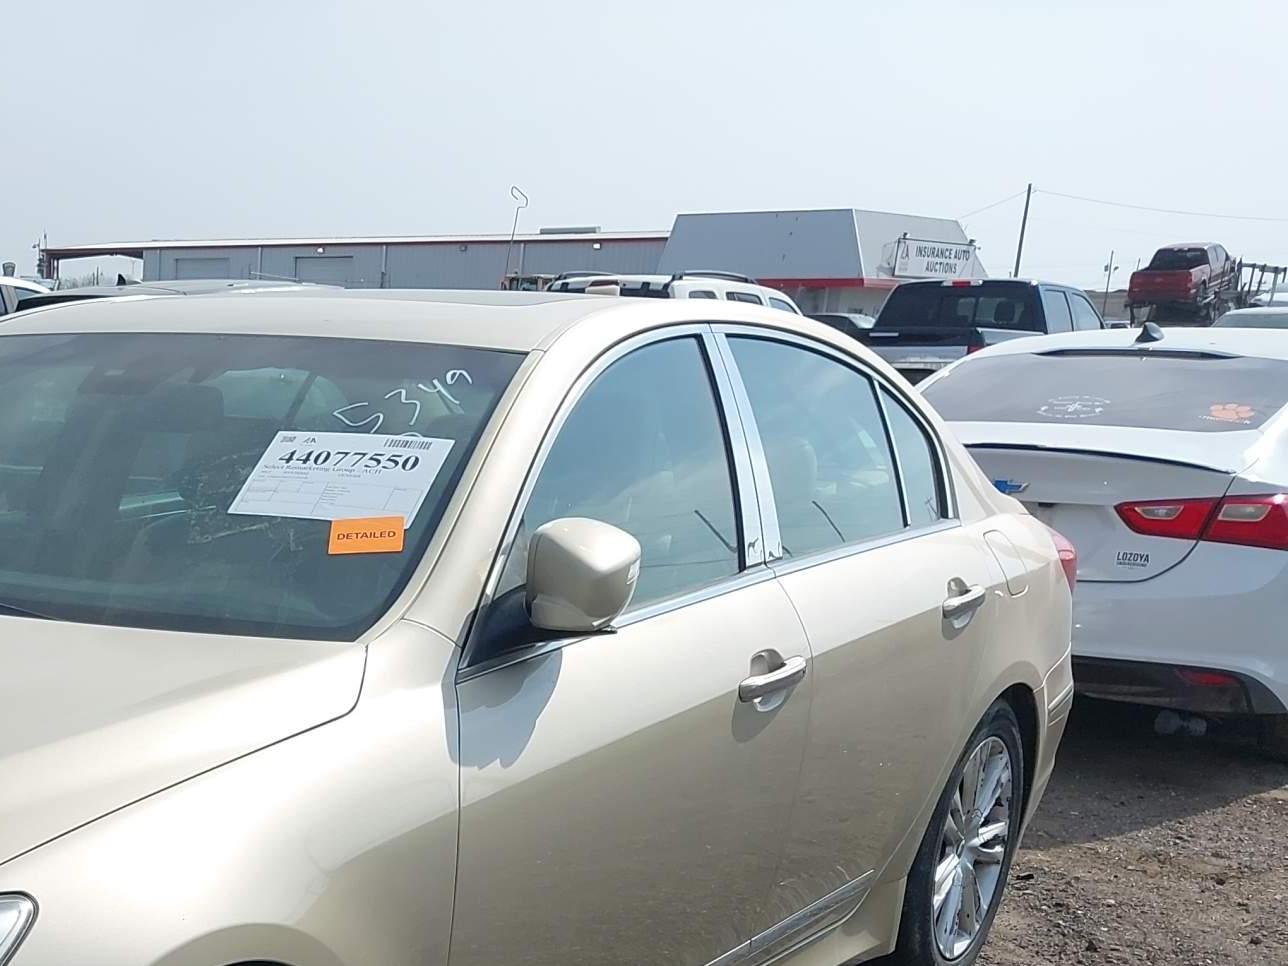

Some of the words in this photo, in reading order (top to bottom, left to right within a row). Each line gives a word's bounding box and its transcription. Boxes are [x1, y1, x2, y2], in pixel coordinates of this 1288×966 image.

[915, 245, 953, 260] INSURANCE
[953, 248, 971, 262] AUTO
[925, 261, 957, 274] AUCTIONS
[278, 448, 421, 472] 44077550
[336, 530, 397, 541] DETAILED
[1117, 551, 1149, 563] LOZOYA
